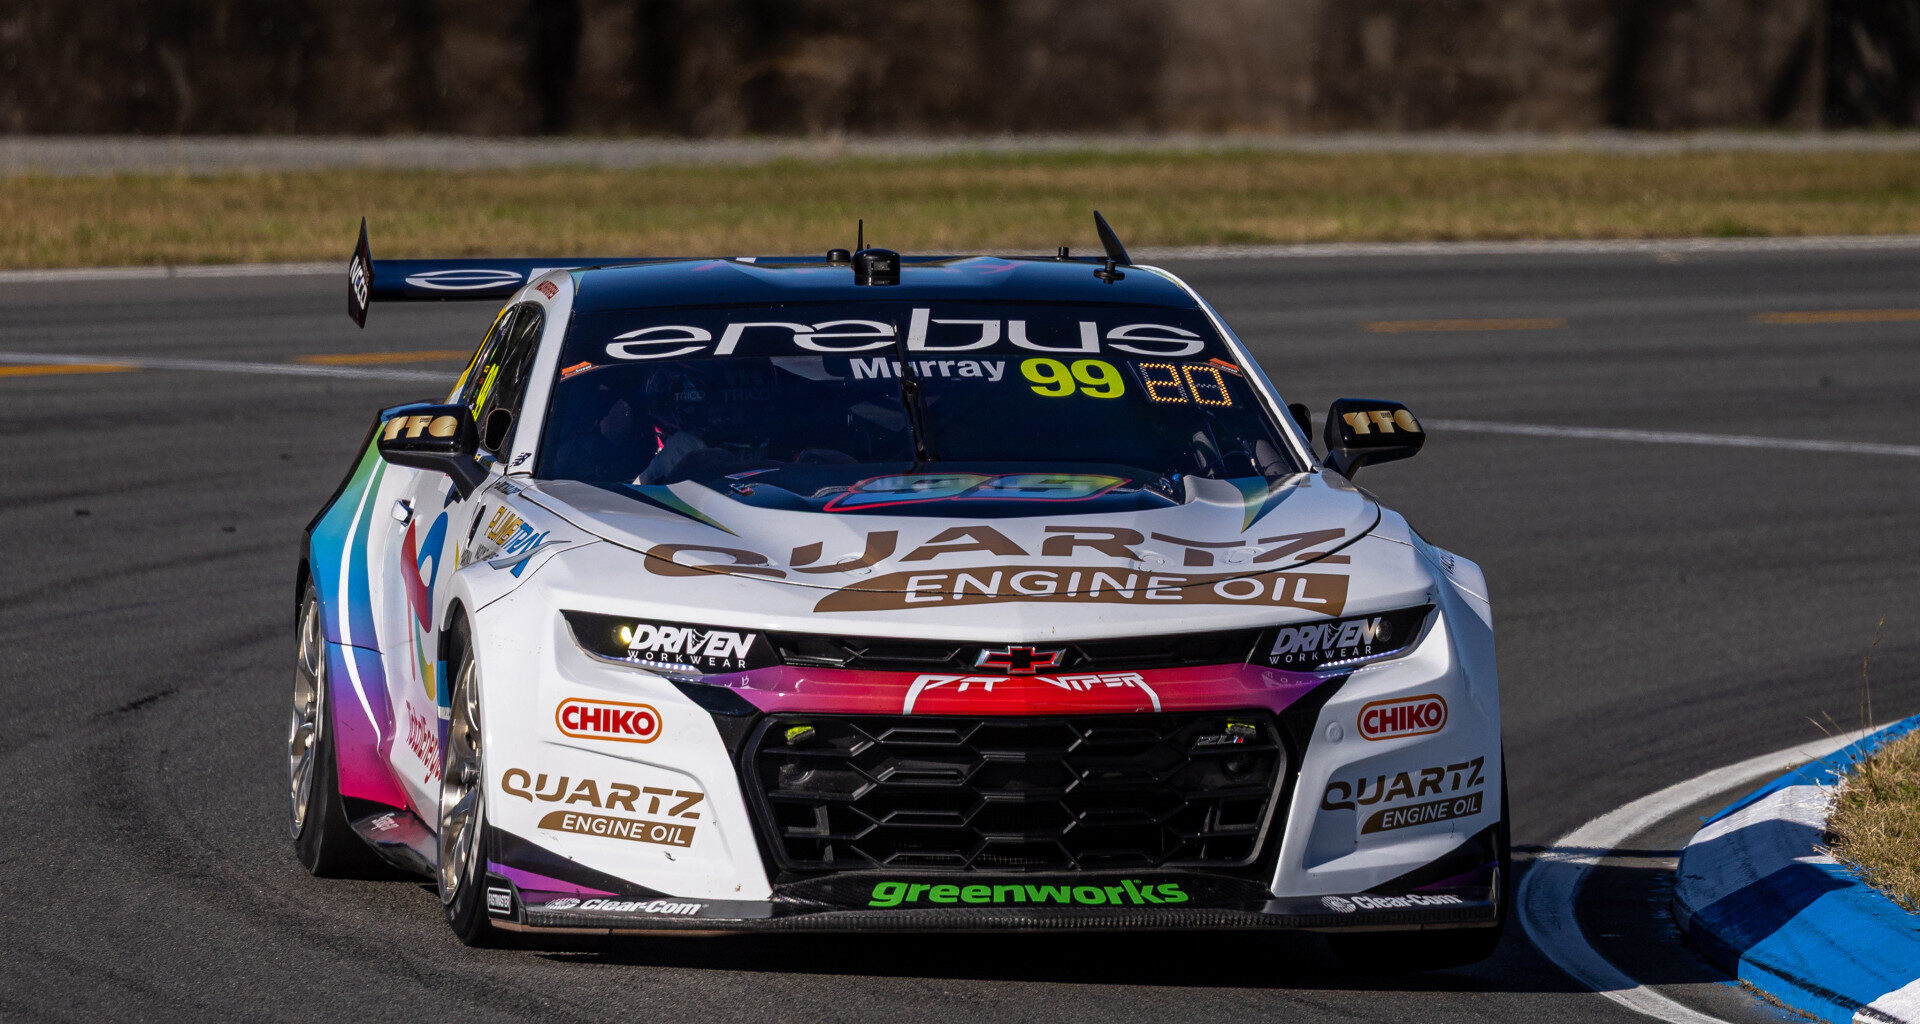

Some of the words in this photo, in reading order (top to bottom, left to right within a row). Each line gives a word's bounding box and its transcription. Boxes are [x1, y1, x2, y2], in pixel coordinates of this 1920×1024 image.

[605, 308, 1205, 360] erebus
[851, 357, 1006, 381] Murray
[1020, 358, 1125, 398] 99
[644, 525, 1350, 578] QUARTZ
[904, 570, 1193, 603] ENGINE
[1213, 577, 1328, 604] OIL
[628, 623, 756, 659] DRIVEN
[1271, 617, 1382, 656] DRIVEN
[628, 650, 746, 669] WORKWEAR
[1269, 645, 1372, 665] WORKWEAR
[562, 705, 656, 736] CHIKO
[1363, 701, 1443, 735] CHIKO
[501, 767, 705, 820] QUARTZ
[1320, 756, 1485, 811] QUARTZ
[562, 812, 643, 840] ENGINE
[650, 824, 686, 846] OIL
[1381, 806, 1447, 829] ENGINE
[1453, 798, 1478, 816] OIL
[580, 898, 702, 915] Clear-Com
[869, 879, 1189, 908] greenworks
[1351, 893, 1464, 909] Clear-Com
